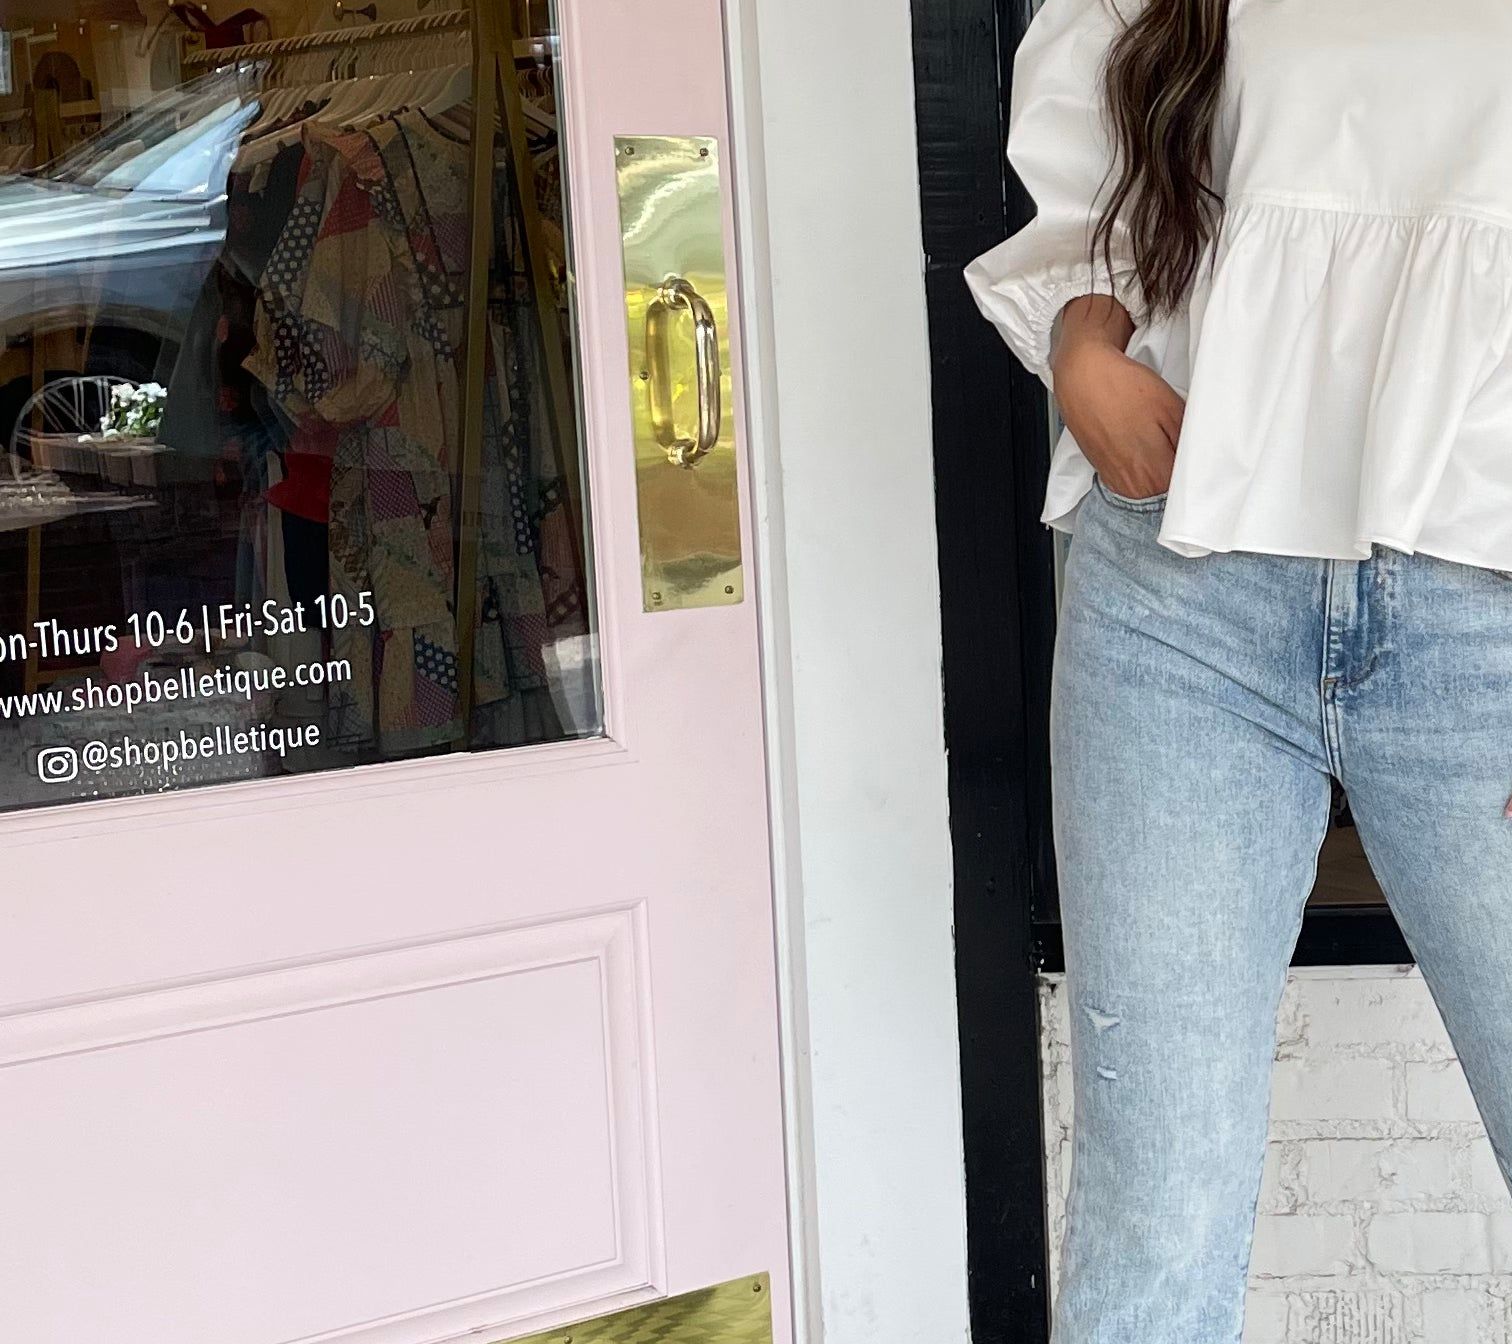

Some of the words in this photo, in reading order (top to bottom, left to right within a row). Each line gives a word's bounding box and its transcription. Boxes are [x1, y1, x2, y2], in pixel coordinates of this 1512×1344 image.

[127, 608, 194, 648] 10-6
[219, 599, 307, 640] Fri-Sat
[314, 591, 375, 629] 10-5
[82, 723, 320, 771] @shopbelletique
